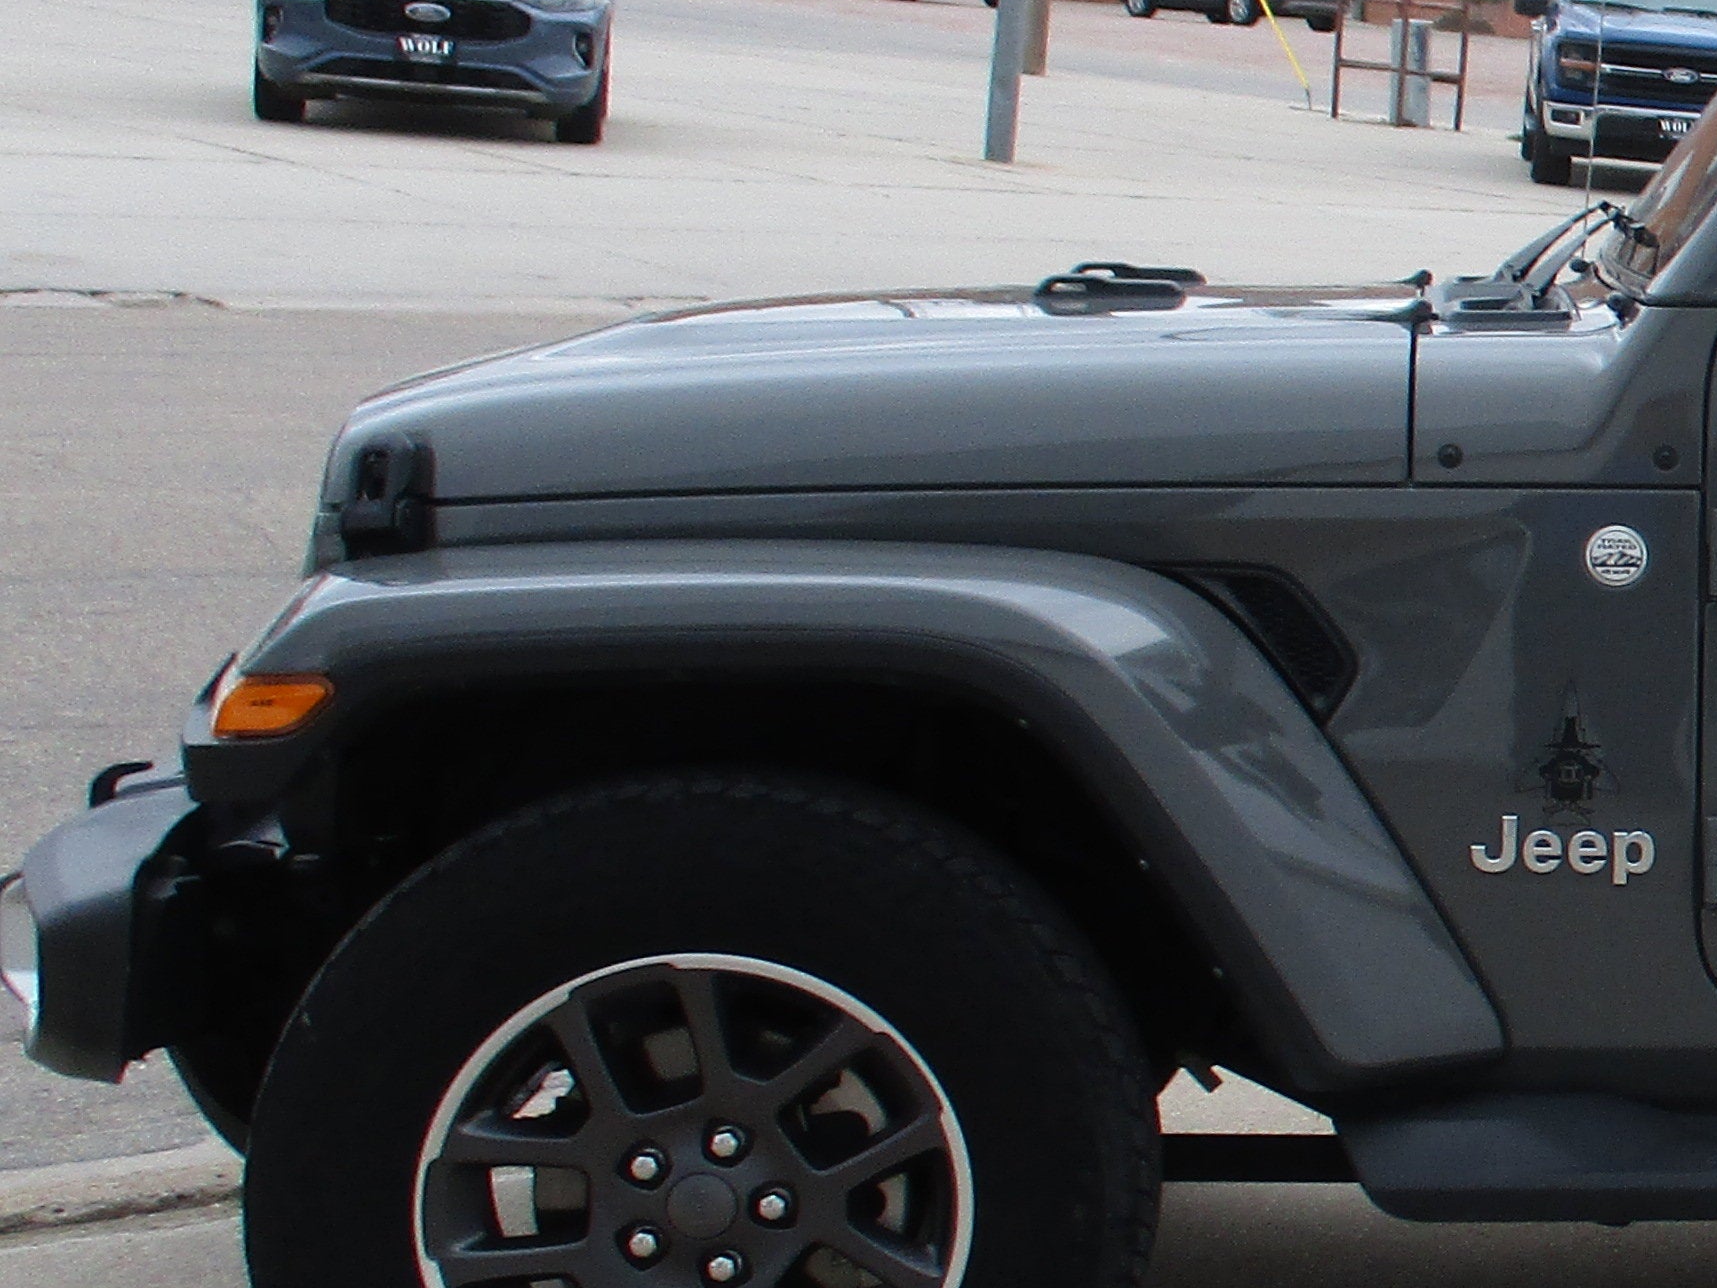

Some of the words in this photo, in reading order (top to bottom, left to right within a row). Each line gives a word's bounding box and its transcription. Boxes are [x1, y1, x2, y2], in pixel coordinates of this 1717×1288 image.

[399, 36, 454, 54] WOLF
[1659, 119, 1695, 133] WOL
[1470, 814, 1656, 886] Jeep
